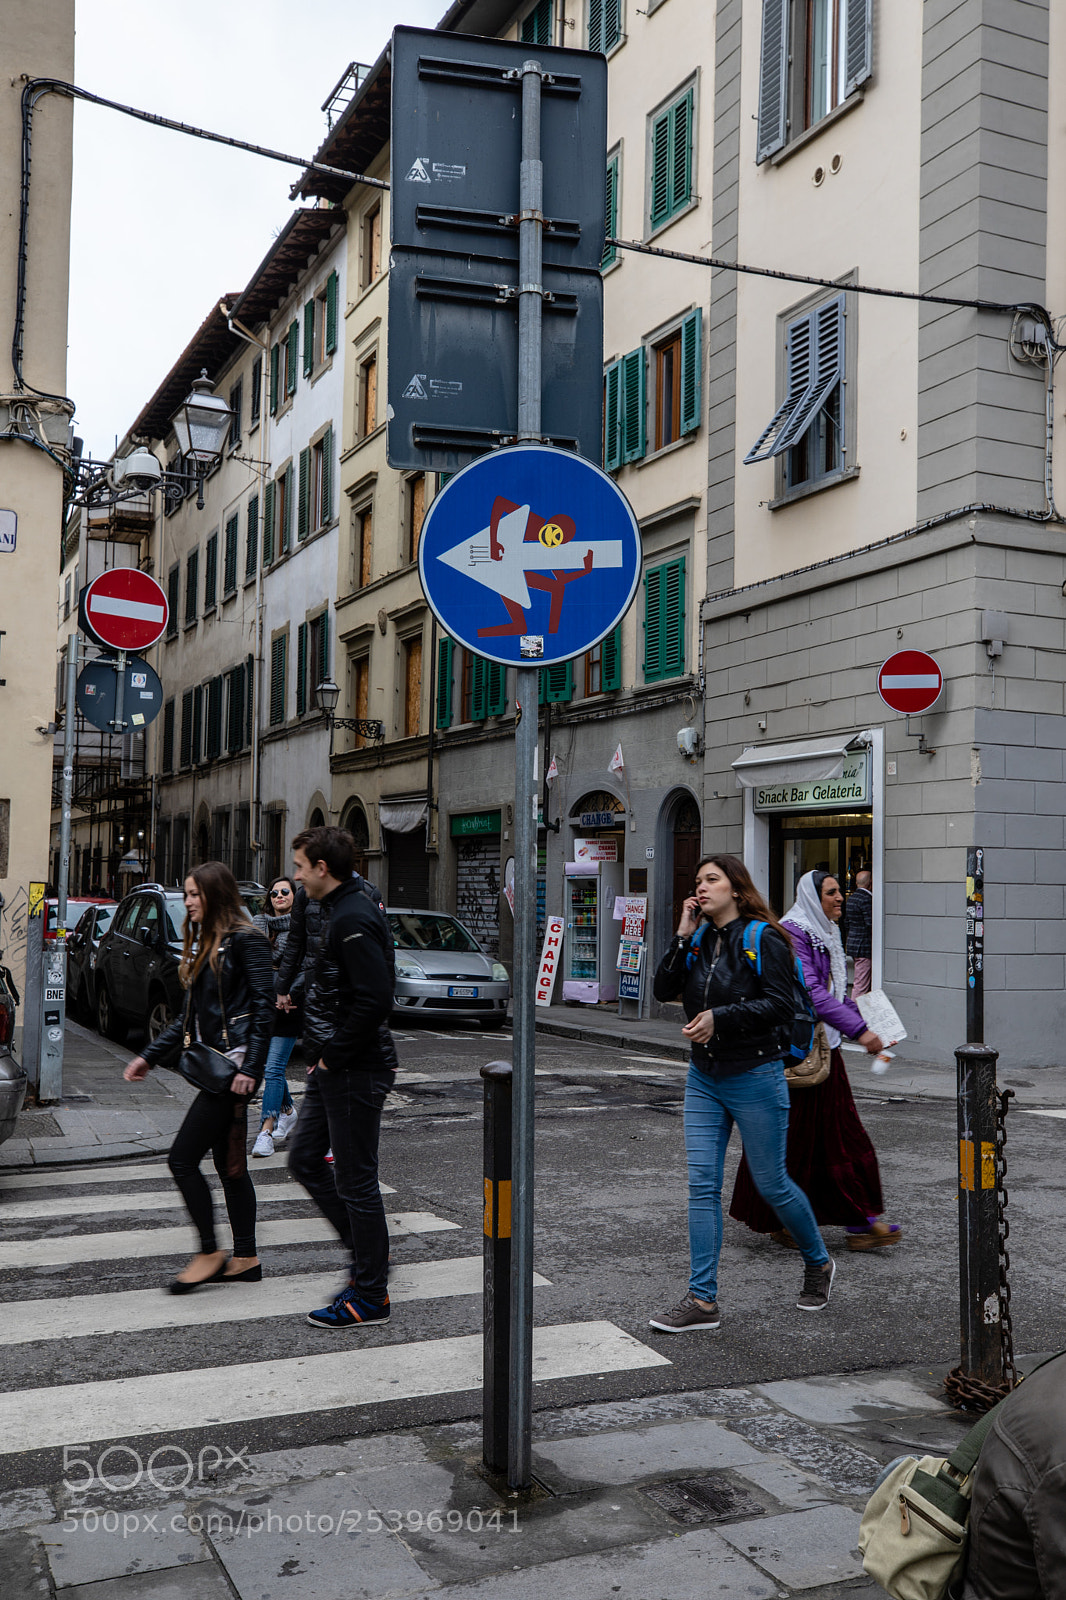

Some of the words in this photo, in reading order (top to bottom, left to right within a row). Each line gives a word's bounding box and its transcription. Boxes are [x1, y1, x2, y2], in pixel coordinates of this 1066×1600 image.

[758, 788, 788, 804] Snack
[791, 787, 809, 802] Bar
[812, 783, 862, 800] Gelateria
[581, 813, 612, 825] CHANGE
[625, 904, 644, 914] CHANGE
[625, 917, 642, 927] BOOK
[624, 926, 642, 937] HERE
[537, 923, 562, 1001] CHANGE
[622, 975, 639, 986] ATM
[46, 990, 64, 1000] BNE
